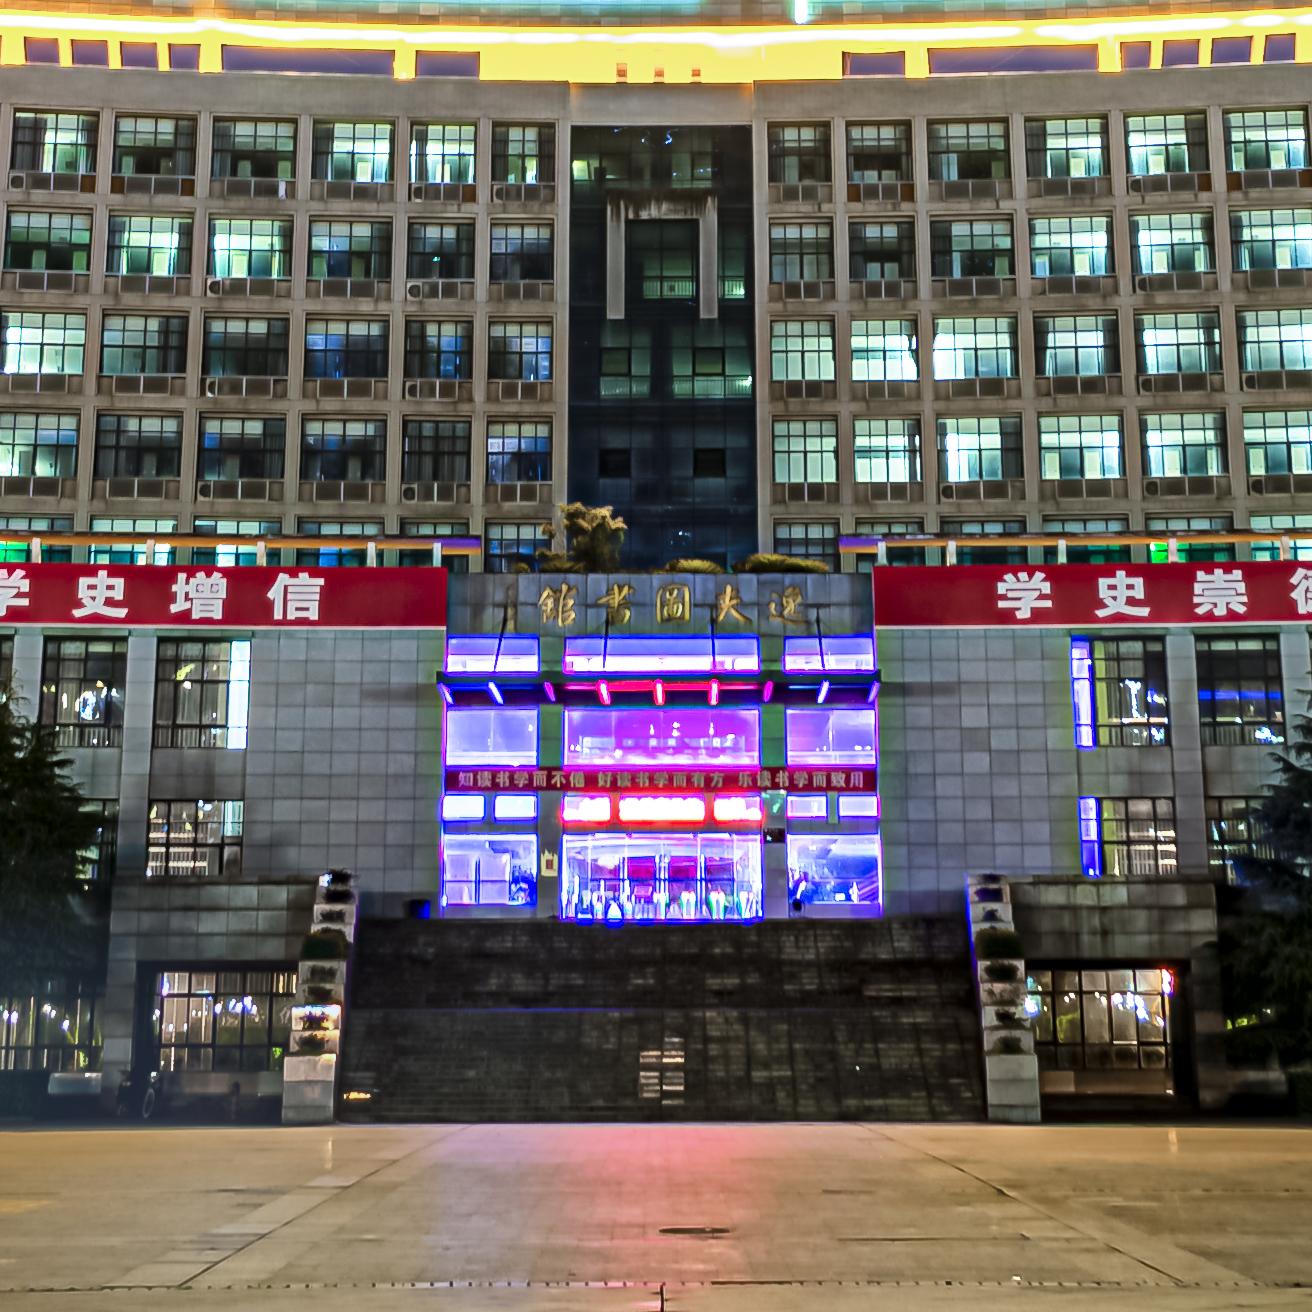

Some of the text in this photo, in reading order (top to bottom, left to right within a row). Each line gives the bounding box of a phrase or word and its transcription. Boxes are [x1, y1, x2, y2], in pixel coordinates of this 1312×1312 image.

[597, 771, 725, 788] 好读书学而有方
